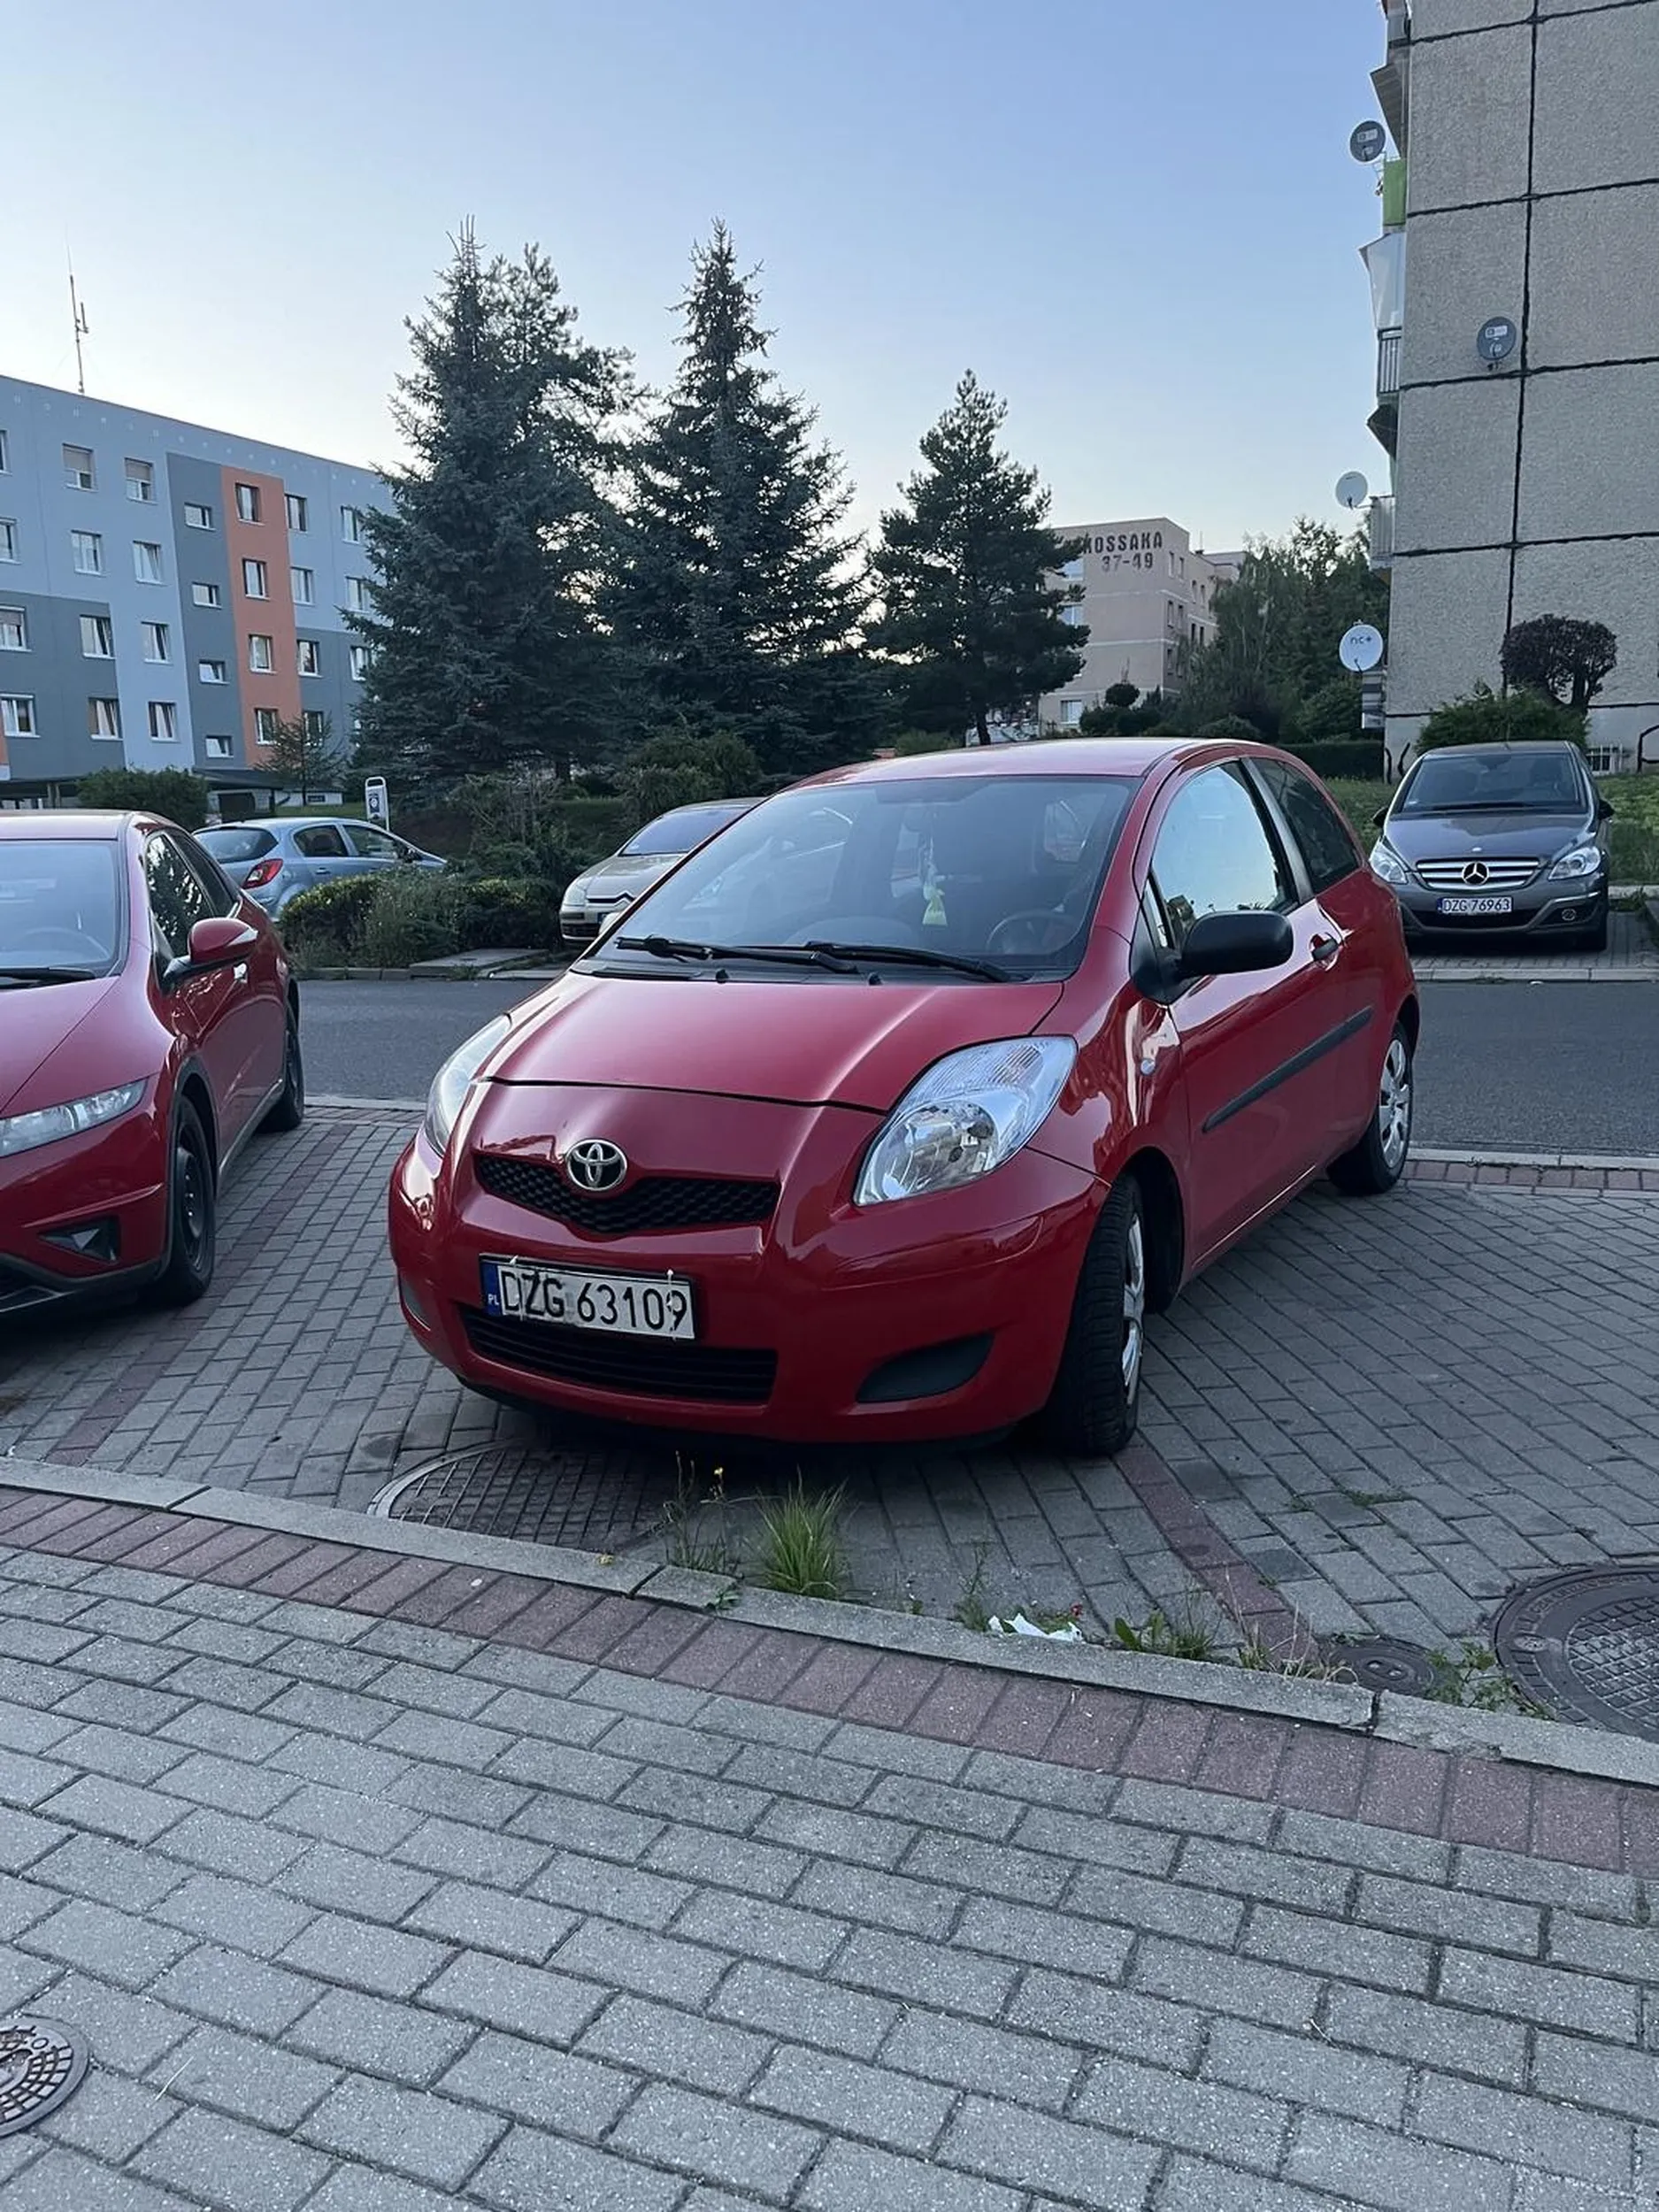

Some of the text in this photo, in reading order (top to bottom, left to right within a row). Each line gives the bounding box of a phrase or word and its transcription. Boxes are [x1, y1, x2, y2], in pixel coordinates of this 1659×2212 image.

[1102, 552, 1153, 572] 37-49
[1350, 635, 1371, 645] nc+
[1444, 898, 1509, 911] DZG 76963
[488, 1293, 499, 1305] PL
[501, 1271, 687, 1332] DZG 63109
